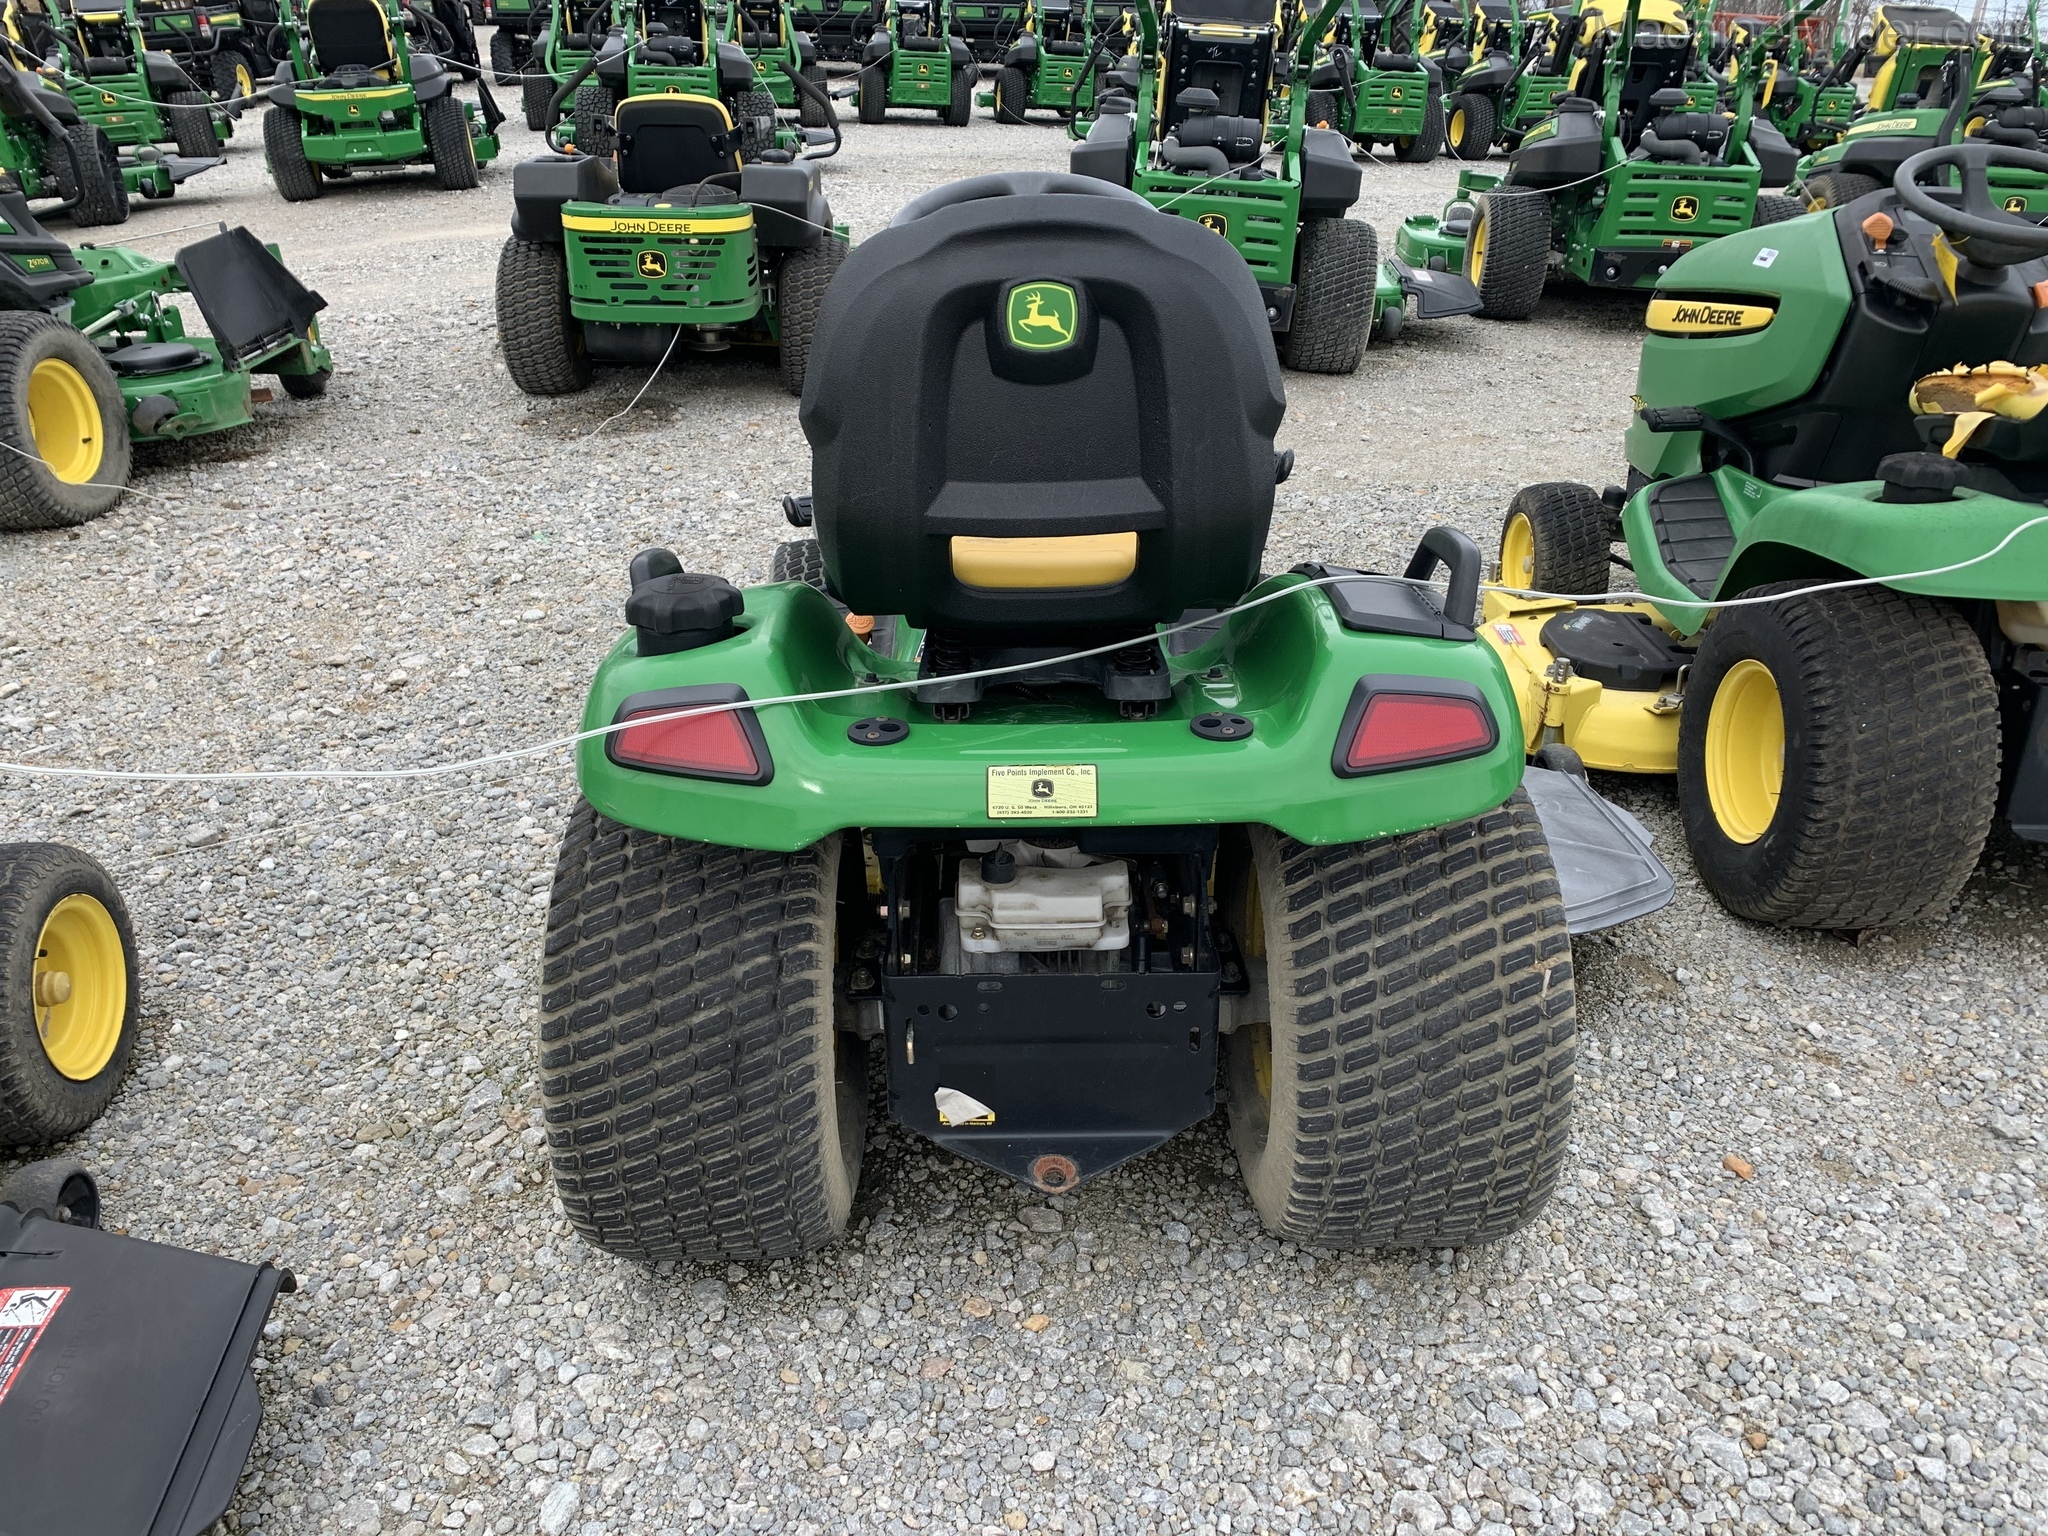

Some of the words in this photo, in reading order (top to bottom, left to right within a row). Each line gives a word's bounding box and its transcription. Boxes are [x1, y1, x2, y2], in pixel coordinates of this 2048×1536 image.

[611, 220, 646, 232] JOHN
[648, 221, 692, 232] DEERE
[1672, 304, 1702, 324] JOHN
[1700, 305, 1745, 326] DEERE
[991, 769, 1006, 777] Five
[1029, 768, 1065, 777] Implement
[1080, 768, 1093, 776] Inc.
